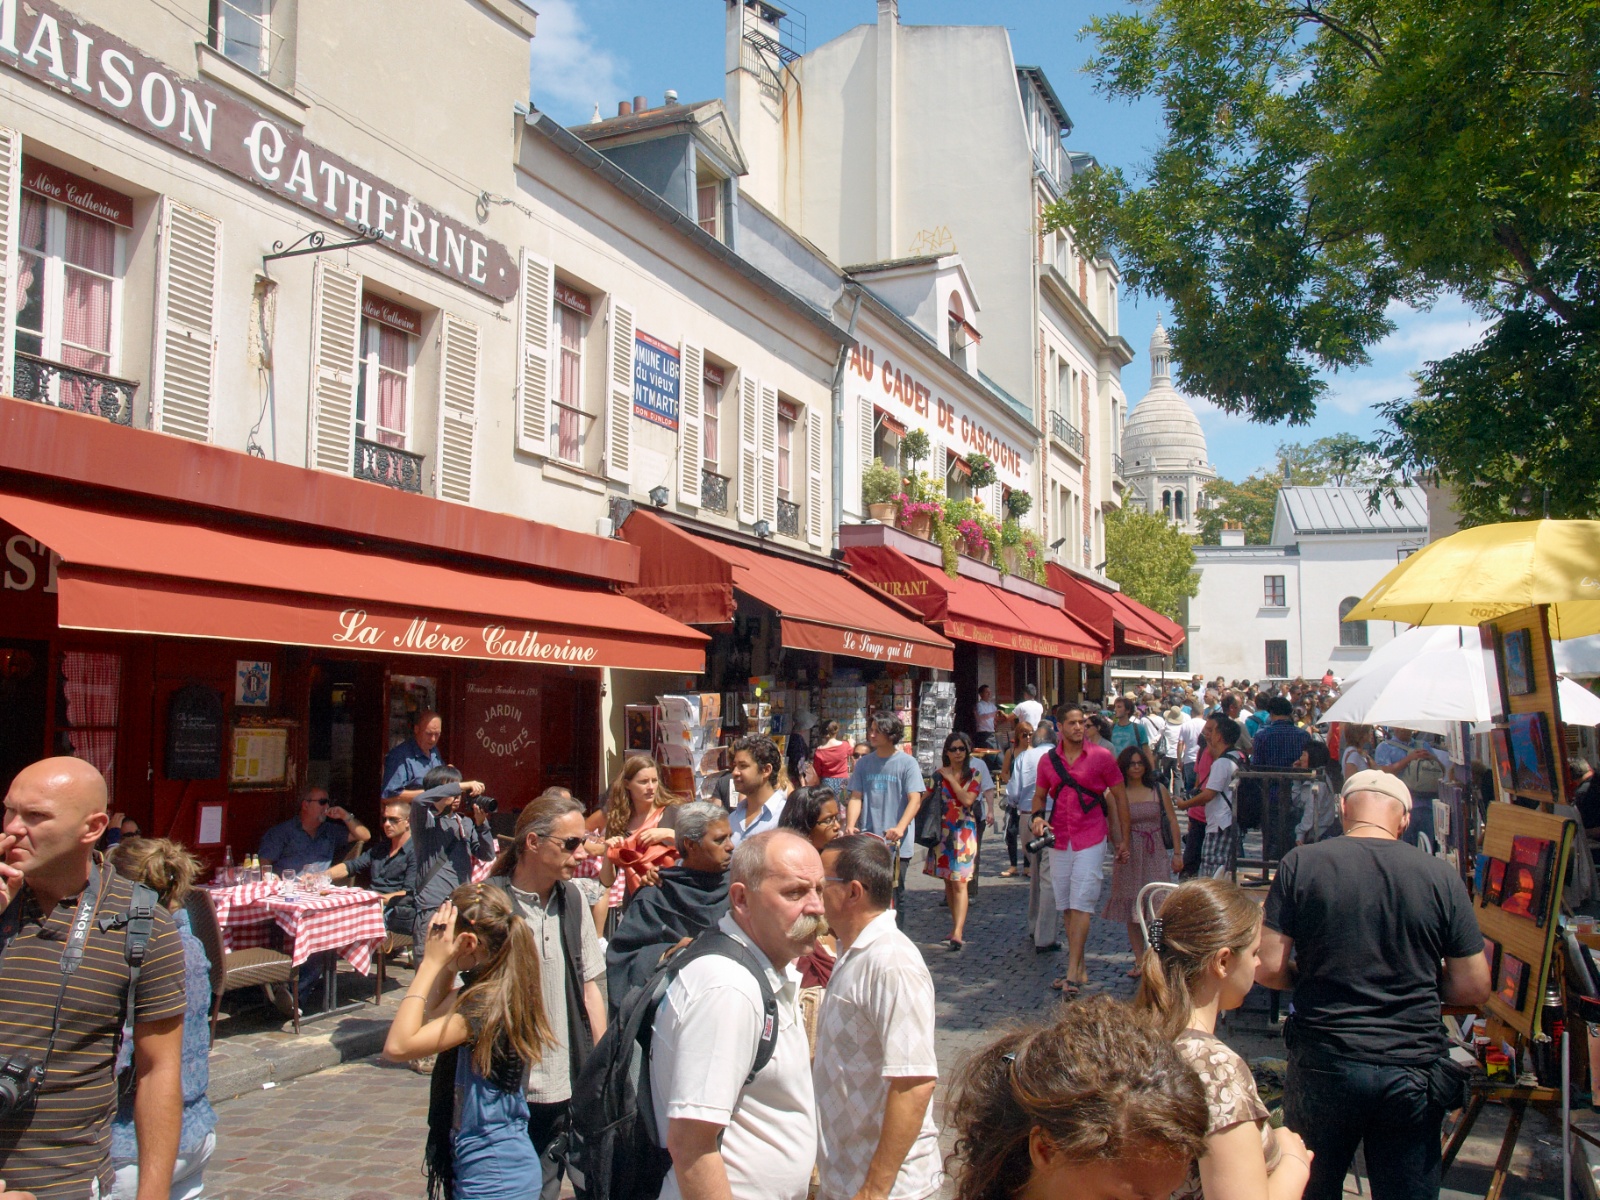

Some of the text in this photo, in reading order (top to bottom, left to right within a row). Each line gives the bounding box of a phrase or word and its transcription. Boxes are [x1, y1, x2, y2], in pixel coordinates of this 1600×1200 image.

[29, 172, 120, 219] Mère Catherine
[243, 121, 489, 284] CATHERINE
[382, 305, 415, 330] Catherine
[636, 362, 674, 394] du vieux
[635, 406, 672, 425] DON DUNLOP
[849, 343, 1020, 478] AU CADET DE GASCOGNE
[332, 608, 385, 644] La
[482, 624, 599, 662] Catherine
[843, 631, 856, 650] Le
[859, 634, 884, 660] Singe
[887, 643, 902, 661] qui
[485, 704, 522, 722] JARDIN
[476, 727, 528, 757] BOSQUETS
[74, 902, 92, 939] SONY
